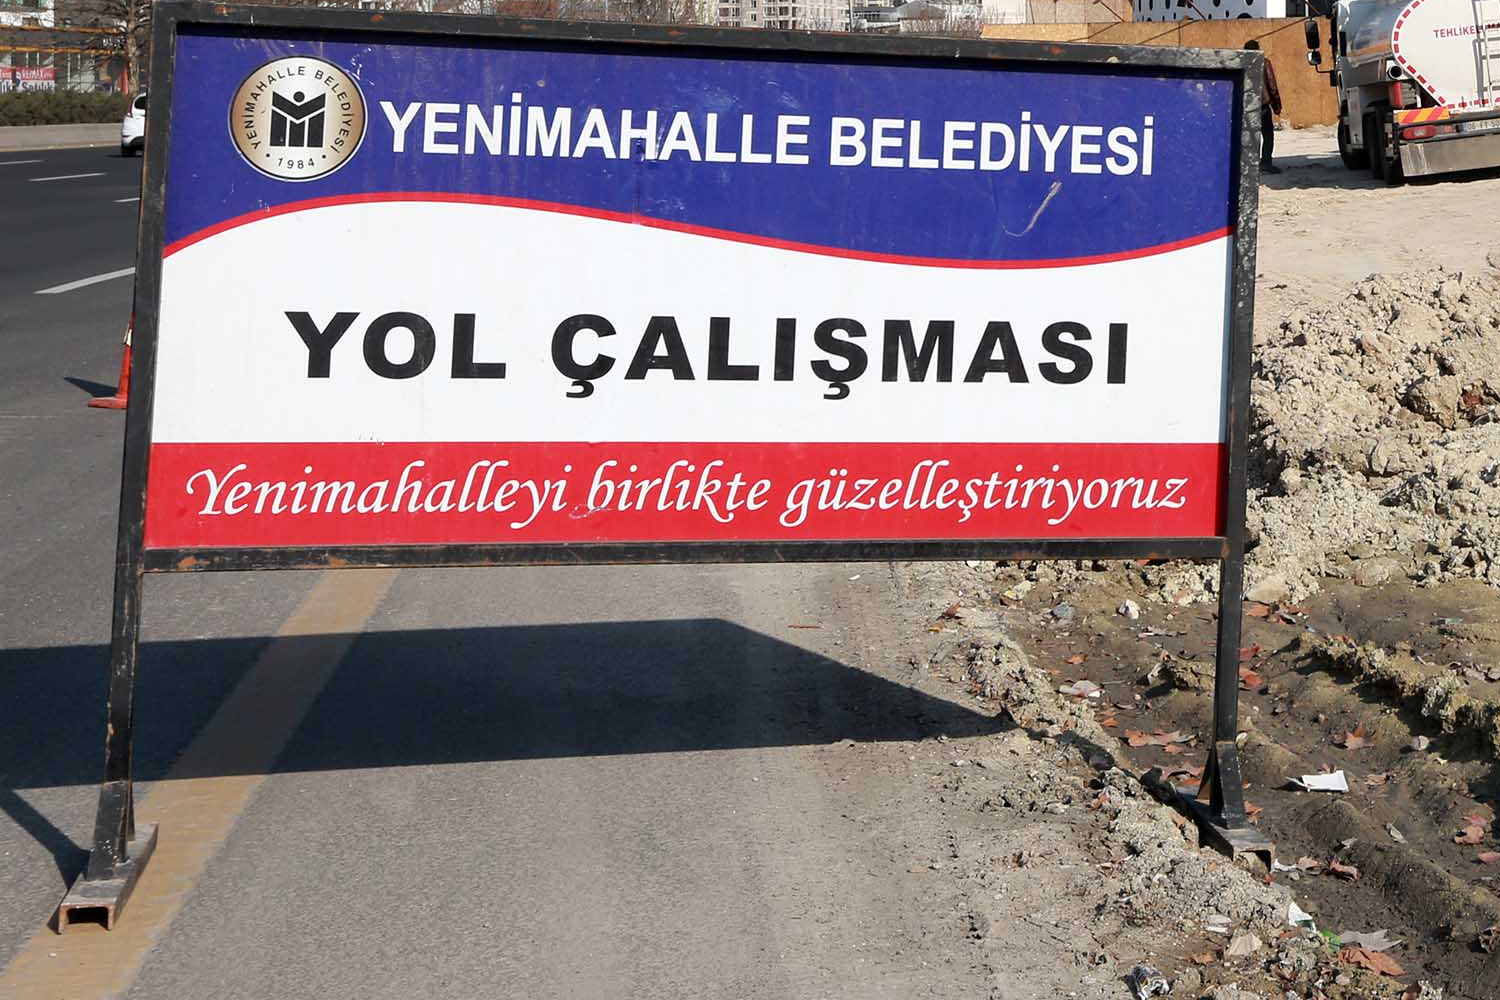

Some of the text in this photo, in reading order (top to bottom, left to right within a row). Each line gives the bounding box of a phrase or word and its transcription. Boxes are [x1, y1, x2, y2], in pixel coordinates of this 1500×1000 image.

[241, 66, 306, 149] YENİMAHALLE
[380, 92, 1154, 176] YENİMAHALLE BELEDİYESİ
[277, 157, 315, 169] 1984
[284, 311, 1128, 400] YOL ÇALIŞMASI
[185, 458, 1189, 530] Yenimahalleyi birlikte güzelleştiriyoruz
